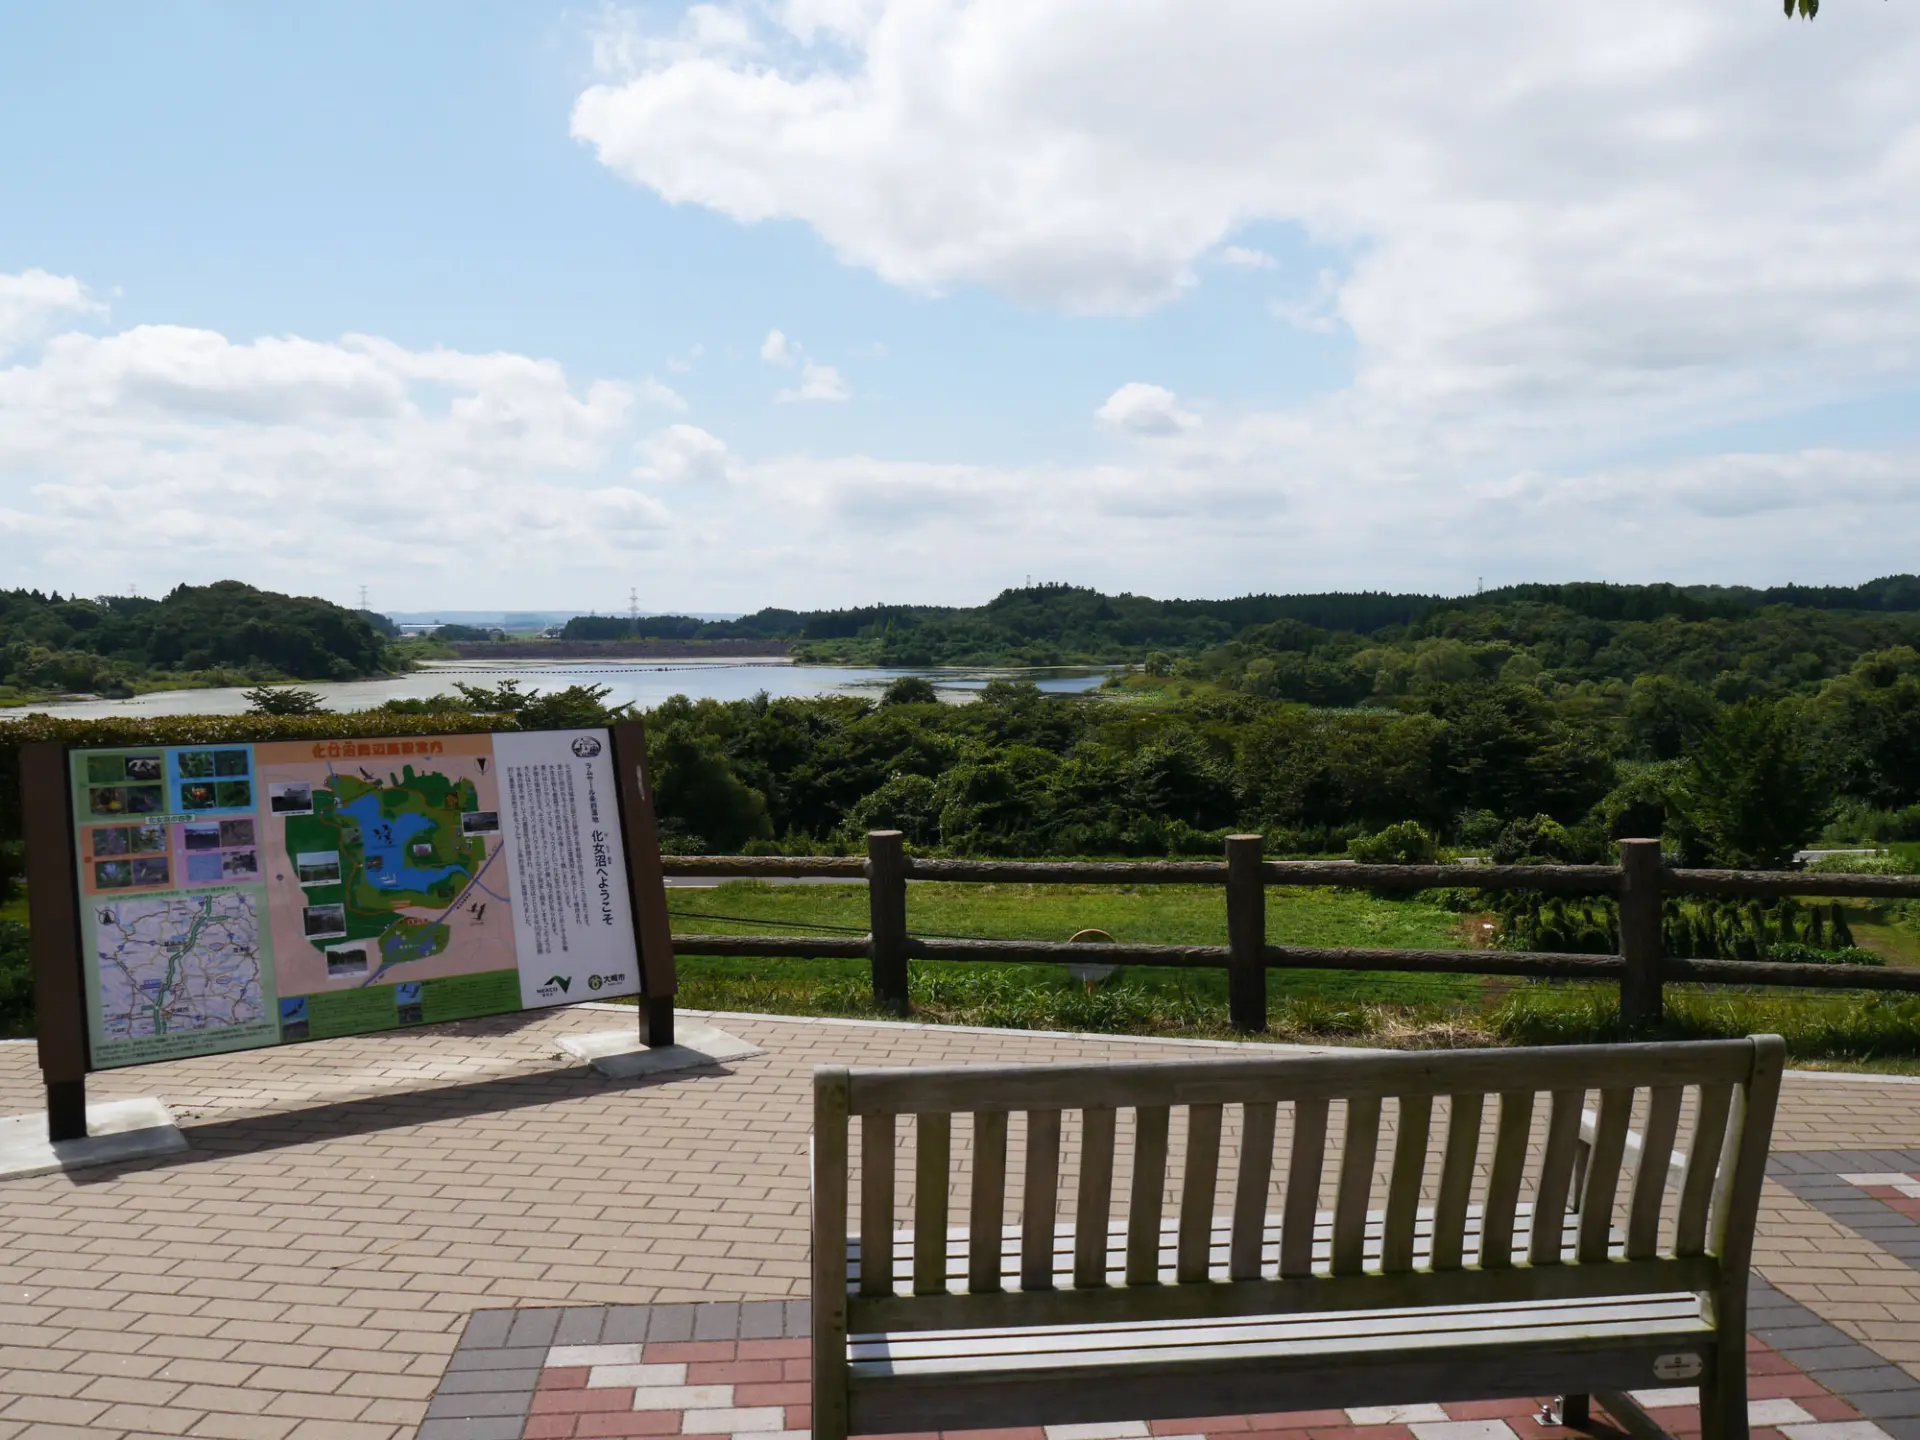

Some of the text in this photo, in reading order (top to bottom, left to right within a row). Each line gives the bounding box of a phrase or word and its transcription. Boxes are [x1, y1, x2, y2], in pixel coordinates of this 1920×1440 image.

[592, 829, 614, 926] 化女沼へようこそ
[603, 973, 626, 983] 大崎市
